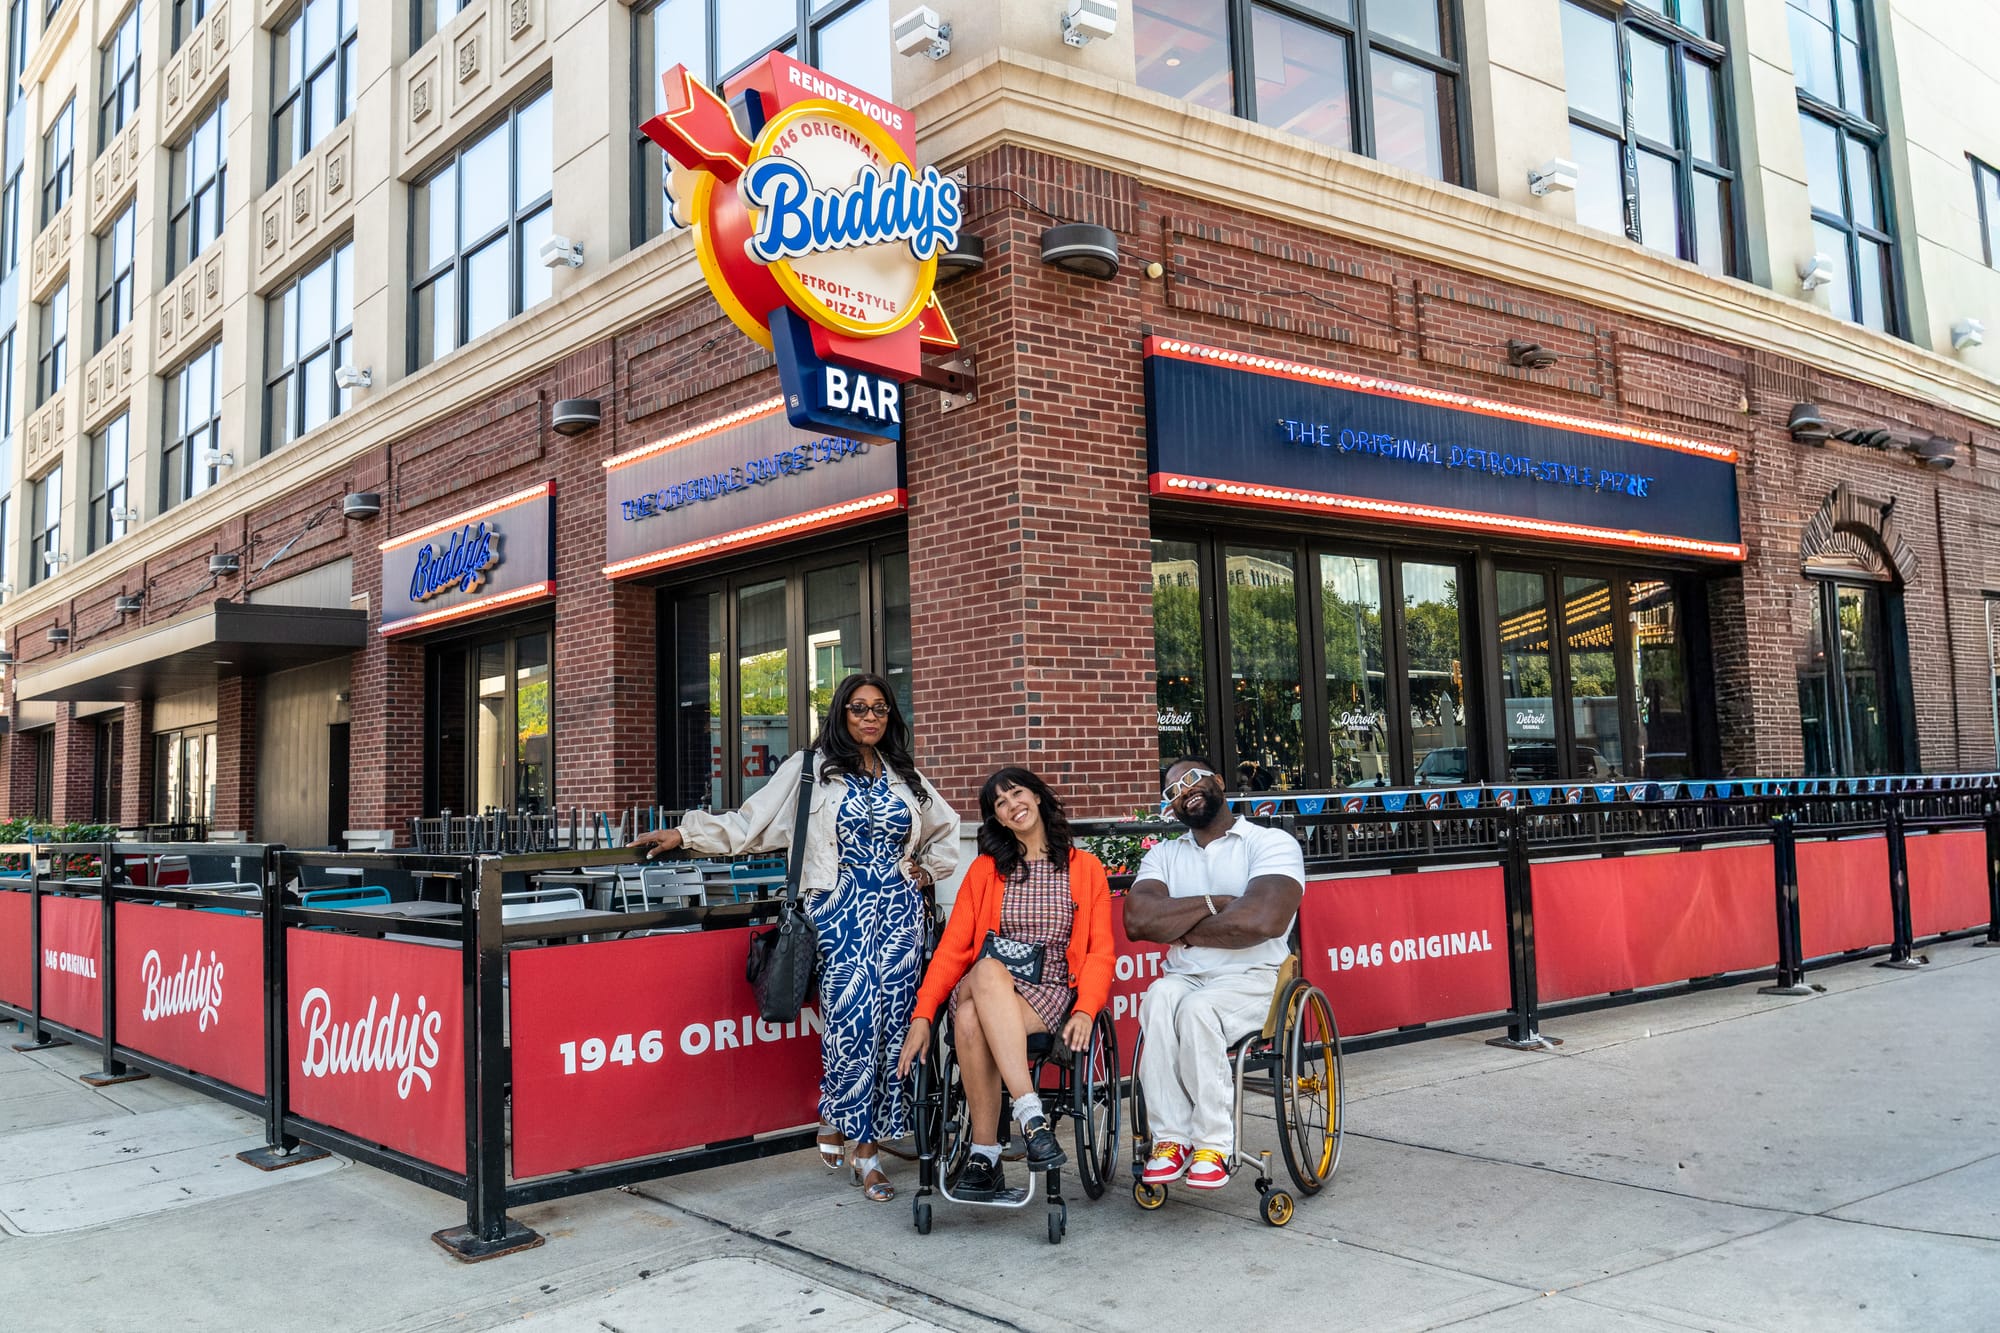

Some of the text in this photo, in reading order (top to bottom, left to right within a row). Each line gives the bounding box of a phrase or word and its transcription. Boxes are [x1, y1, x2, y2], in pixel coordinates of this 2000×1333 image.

[789, 66, 903, 130] RENDEZVOUS
[801, 121, 879, 166] ORIGINAL
[751, 162, 958, 255] Buddy's
[825, 298, 867, 320] PIZZA
[825, 366, 901, 423] BAR
[1285, 420, 1331, 447] THE
[1340, 429, 1442, 464] ORIGINAL
[620, 493, 653, 521] THE
[656, 467, 743, 511] ORIGINAL
[409, 521, 496, 602] Buddy's
[1341, 711, 1377, 726] Detroit
[1516, 711, 1546, 725] Detroit
[1328, 929, 1493, 972] 1946 ORIGINAL
[141, 949, 224, 1033] Buddy's
[300, 986, 442, 1100] Buddy's
[559, 1029, 664, 1075] 1946
